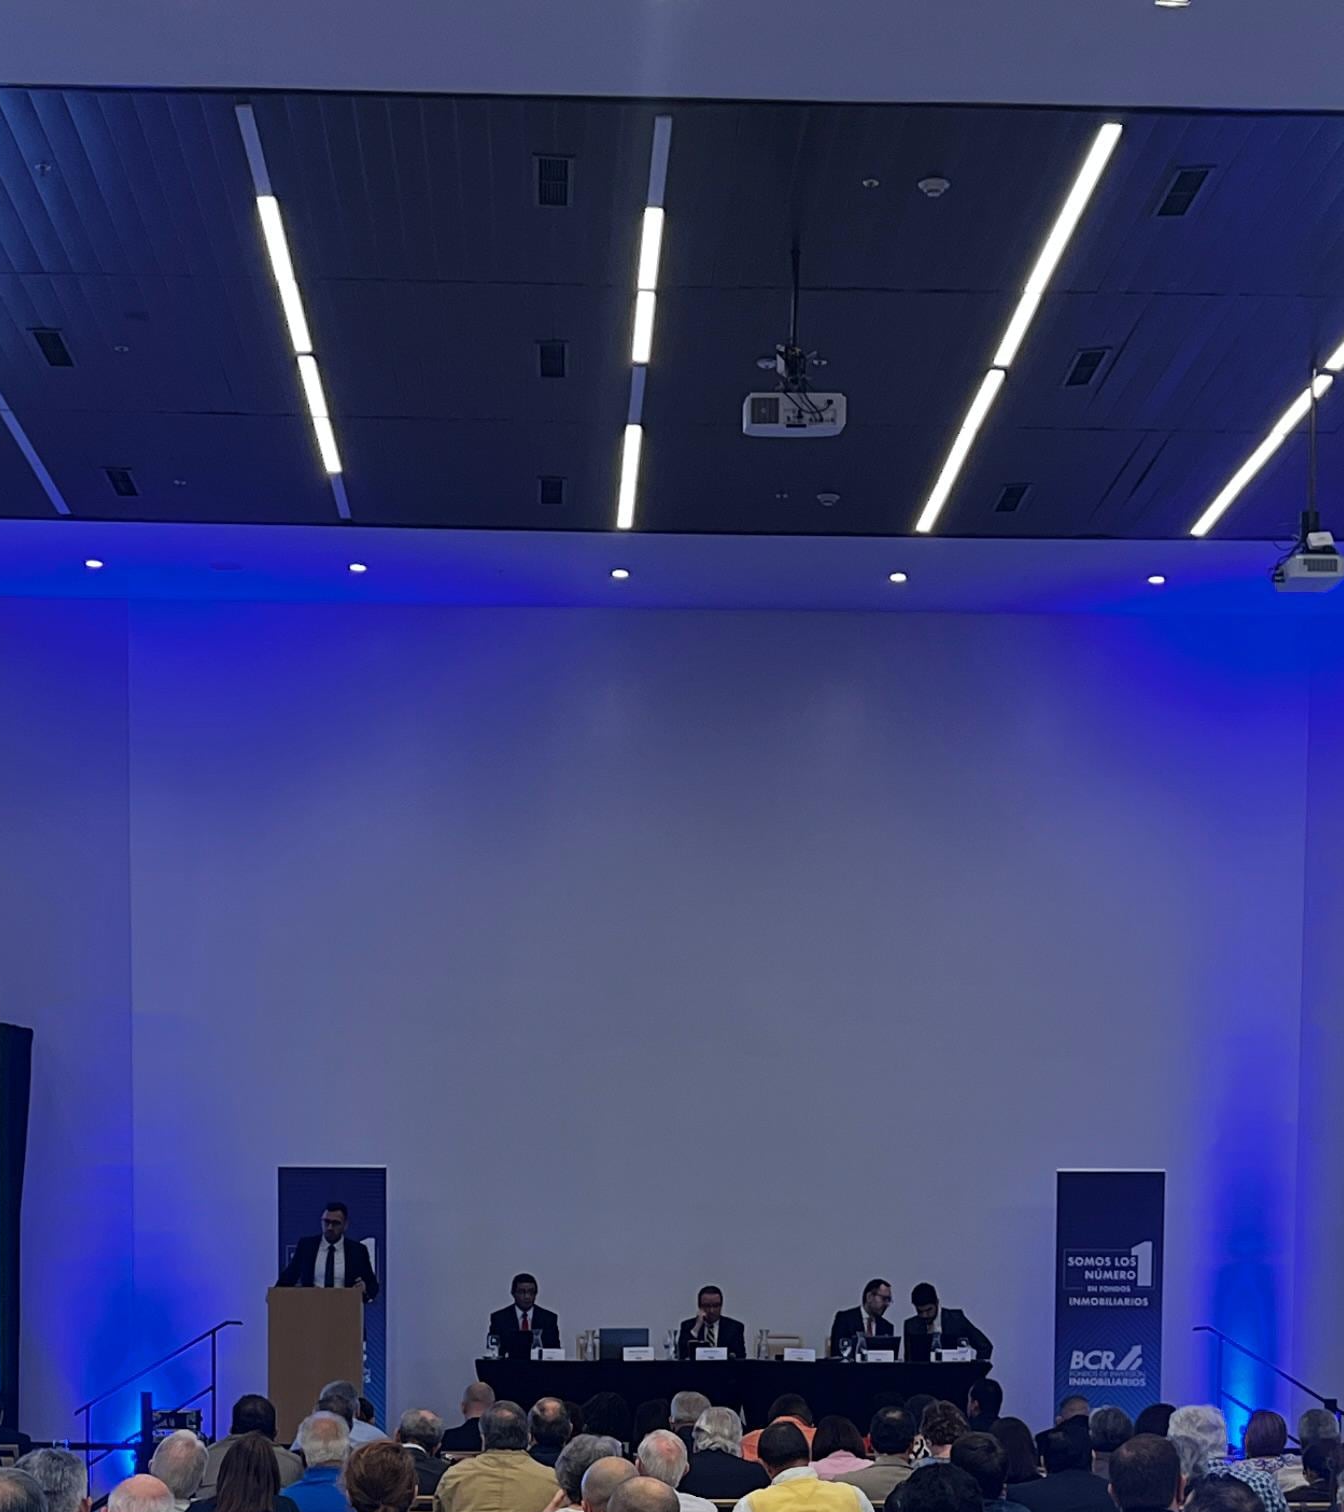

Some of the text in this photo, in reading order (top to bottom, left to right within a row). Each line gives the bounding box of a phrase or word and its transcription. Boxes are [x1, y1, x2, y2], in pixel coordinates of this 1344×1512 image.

[1068, 1257, 1136, 1266] SOMOS LOS
[1085, 1241, 1152, 1286] NÚMERO 1
[1069, 1297, 1148, 1306] INMOBILIARIOS
[1070, 1350, 1115, 1370] BCR
[1069, 1378, 1146, 1386] INMOBILIARIOS
